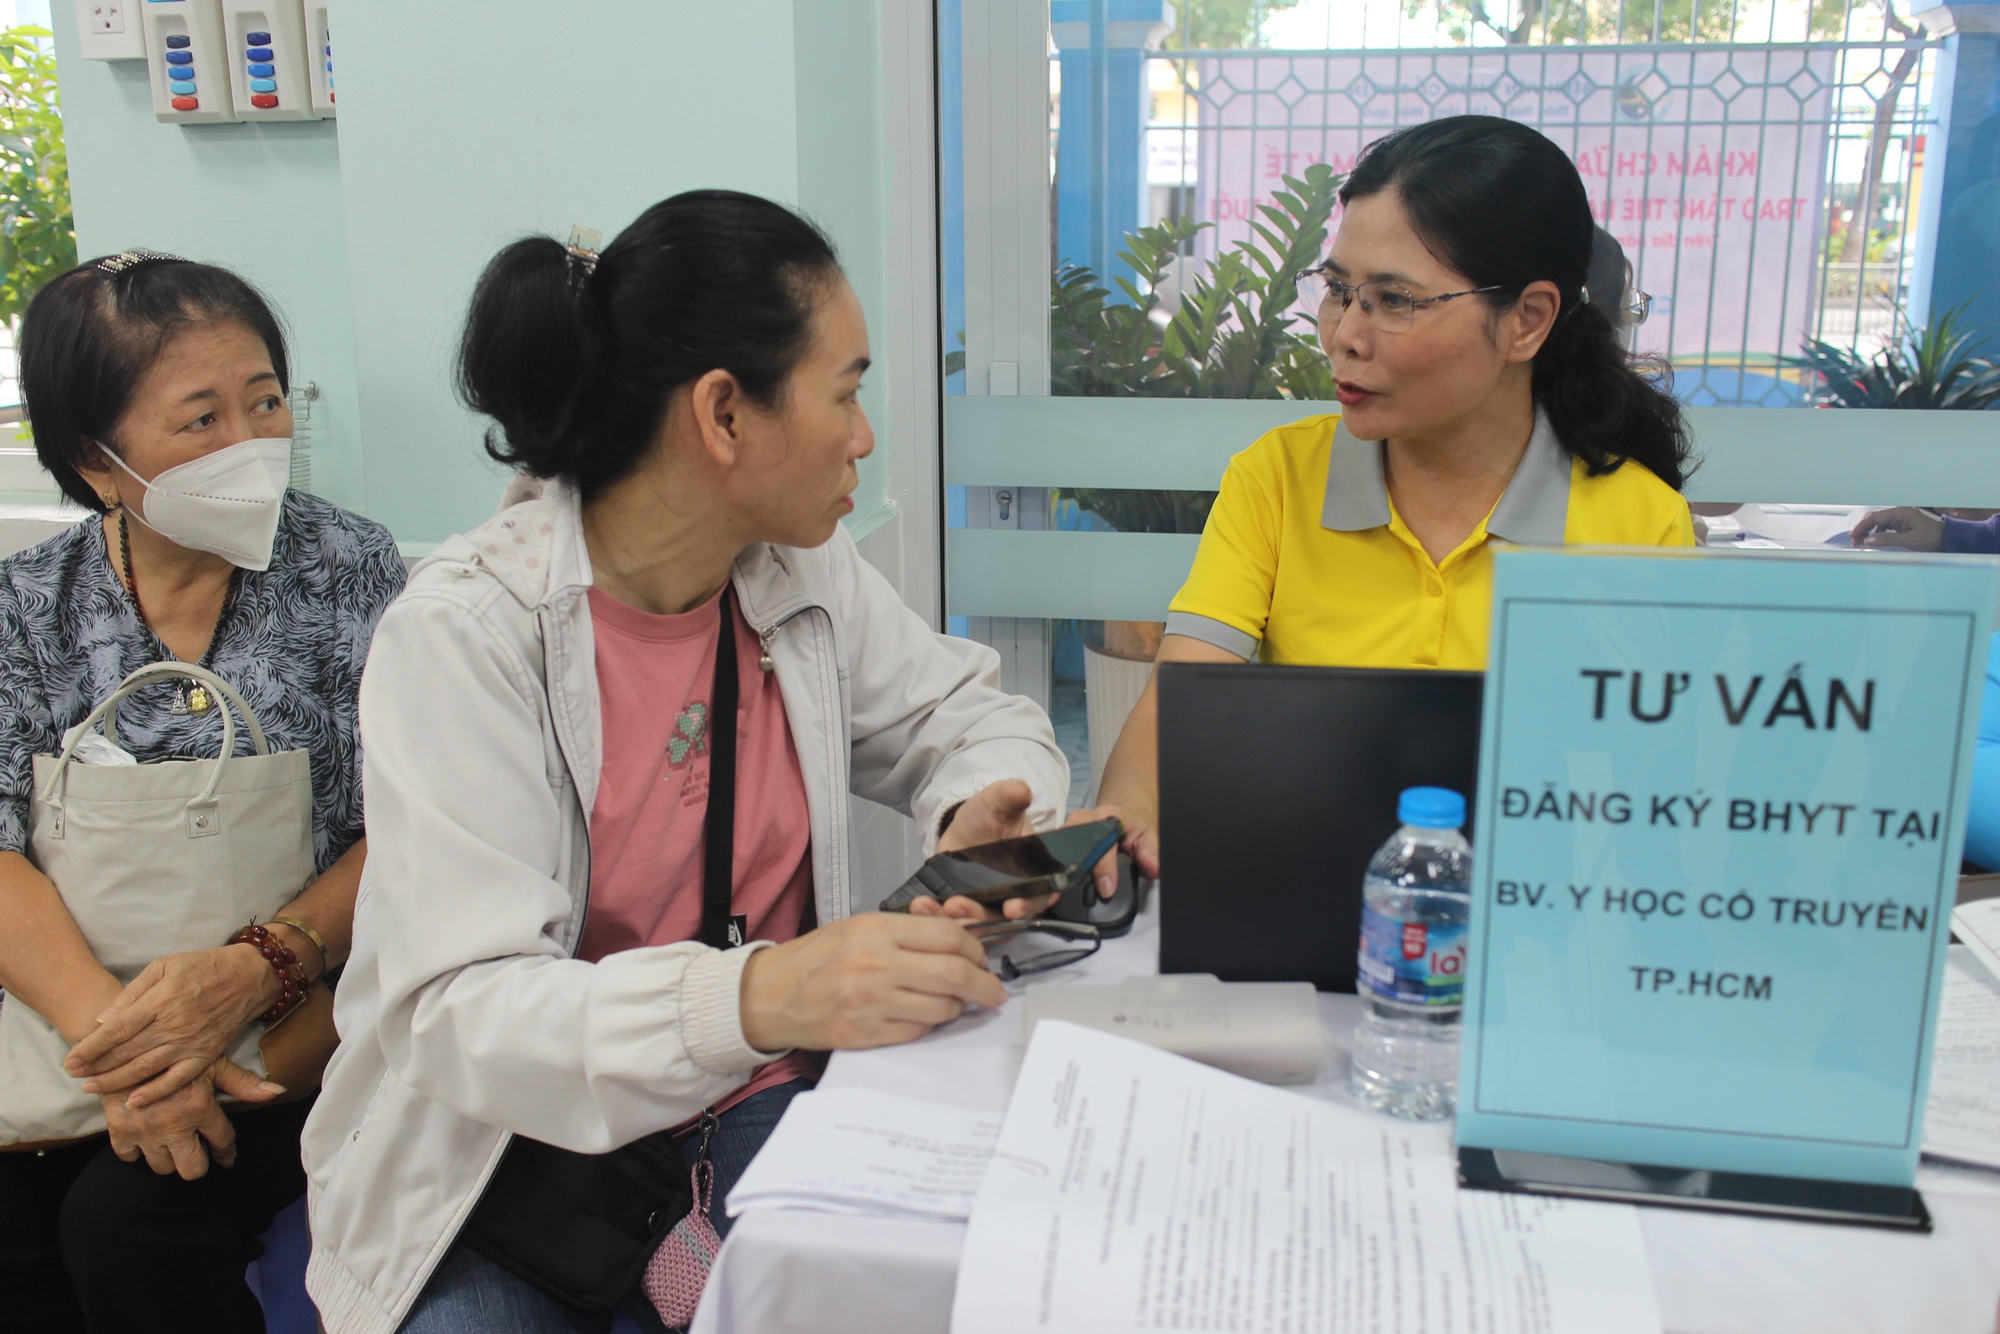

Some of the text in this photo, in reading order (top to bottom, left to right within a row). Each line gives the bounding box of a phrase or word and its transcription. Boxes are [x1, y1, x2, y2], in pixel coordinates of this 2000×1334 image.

[1579, 662, 1878, 735] TƯ VẤN
[1501, 781, 1941, 850] ĐĂNG KÝ BHYT TẠI
[1496, 880, 1555, 911] BV.
[1568, 885, 1593, 912] Y
[1604, 887, 1687, 923] HỌC
[1630, 966, 1775, 1002] TP.HCM
